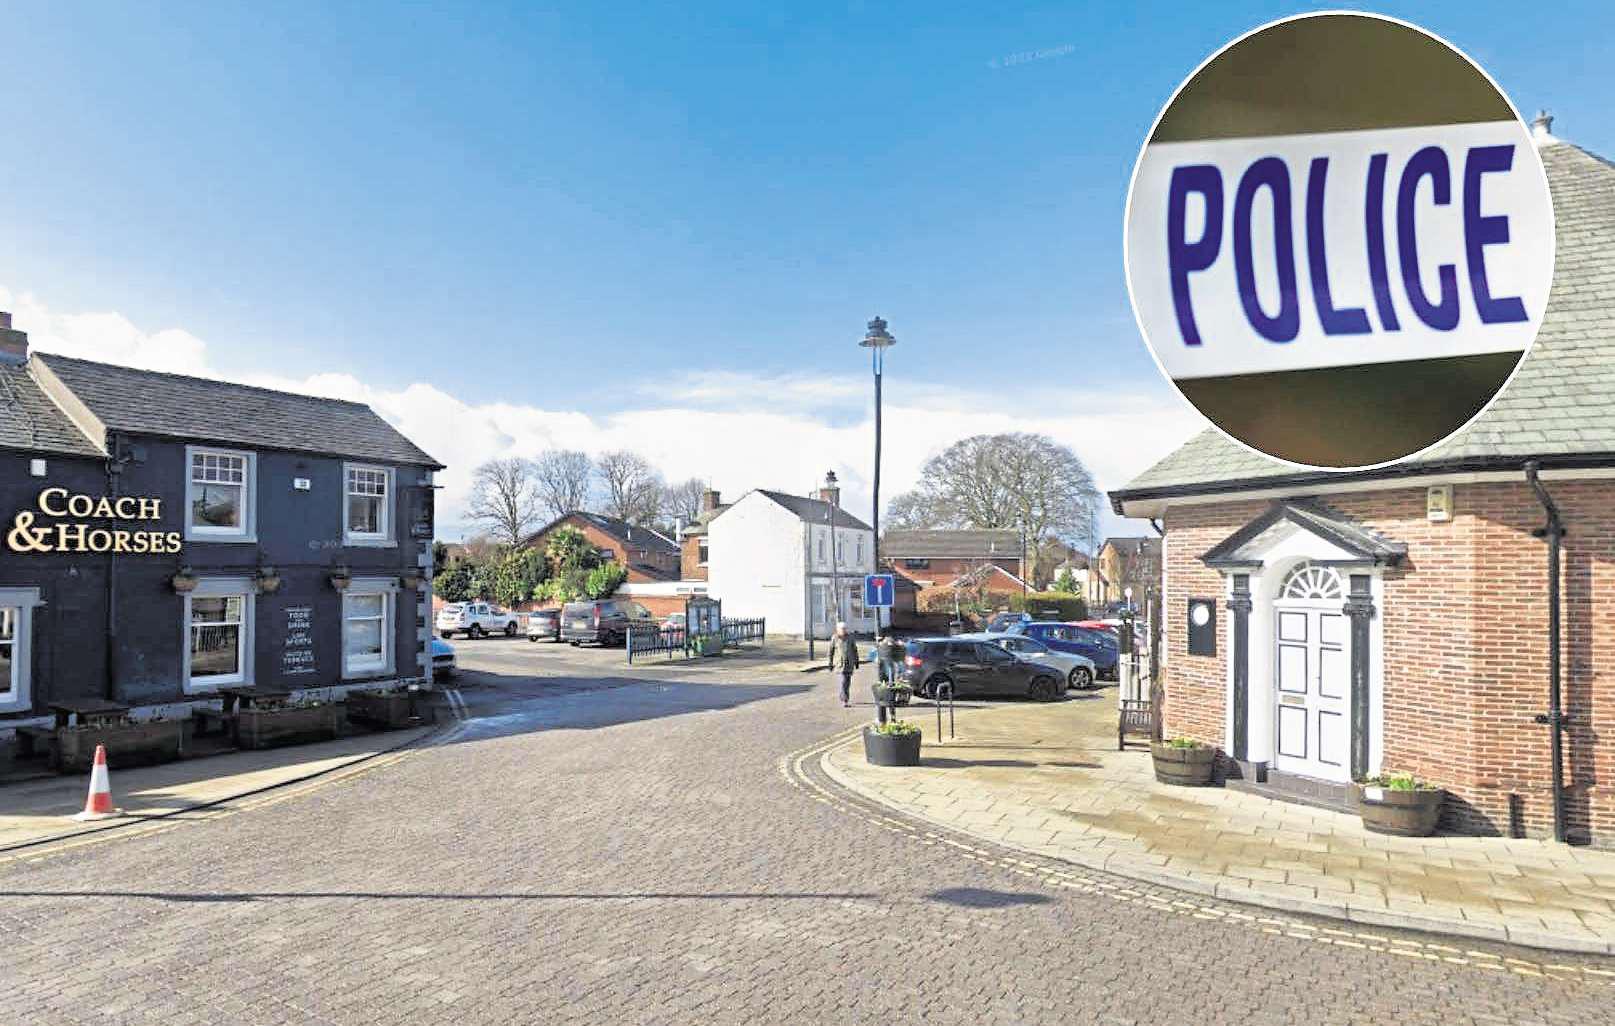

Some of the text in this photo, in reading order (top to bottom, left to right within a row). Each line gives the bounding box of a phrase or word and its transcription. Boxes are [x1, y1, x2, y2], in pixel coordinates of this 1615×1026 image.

[38, 487, 161, 520] COACH
[7, 511, 182, 553] & HORSES
